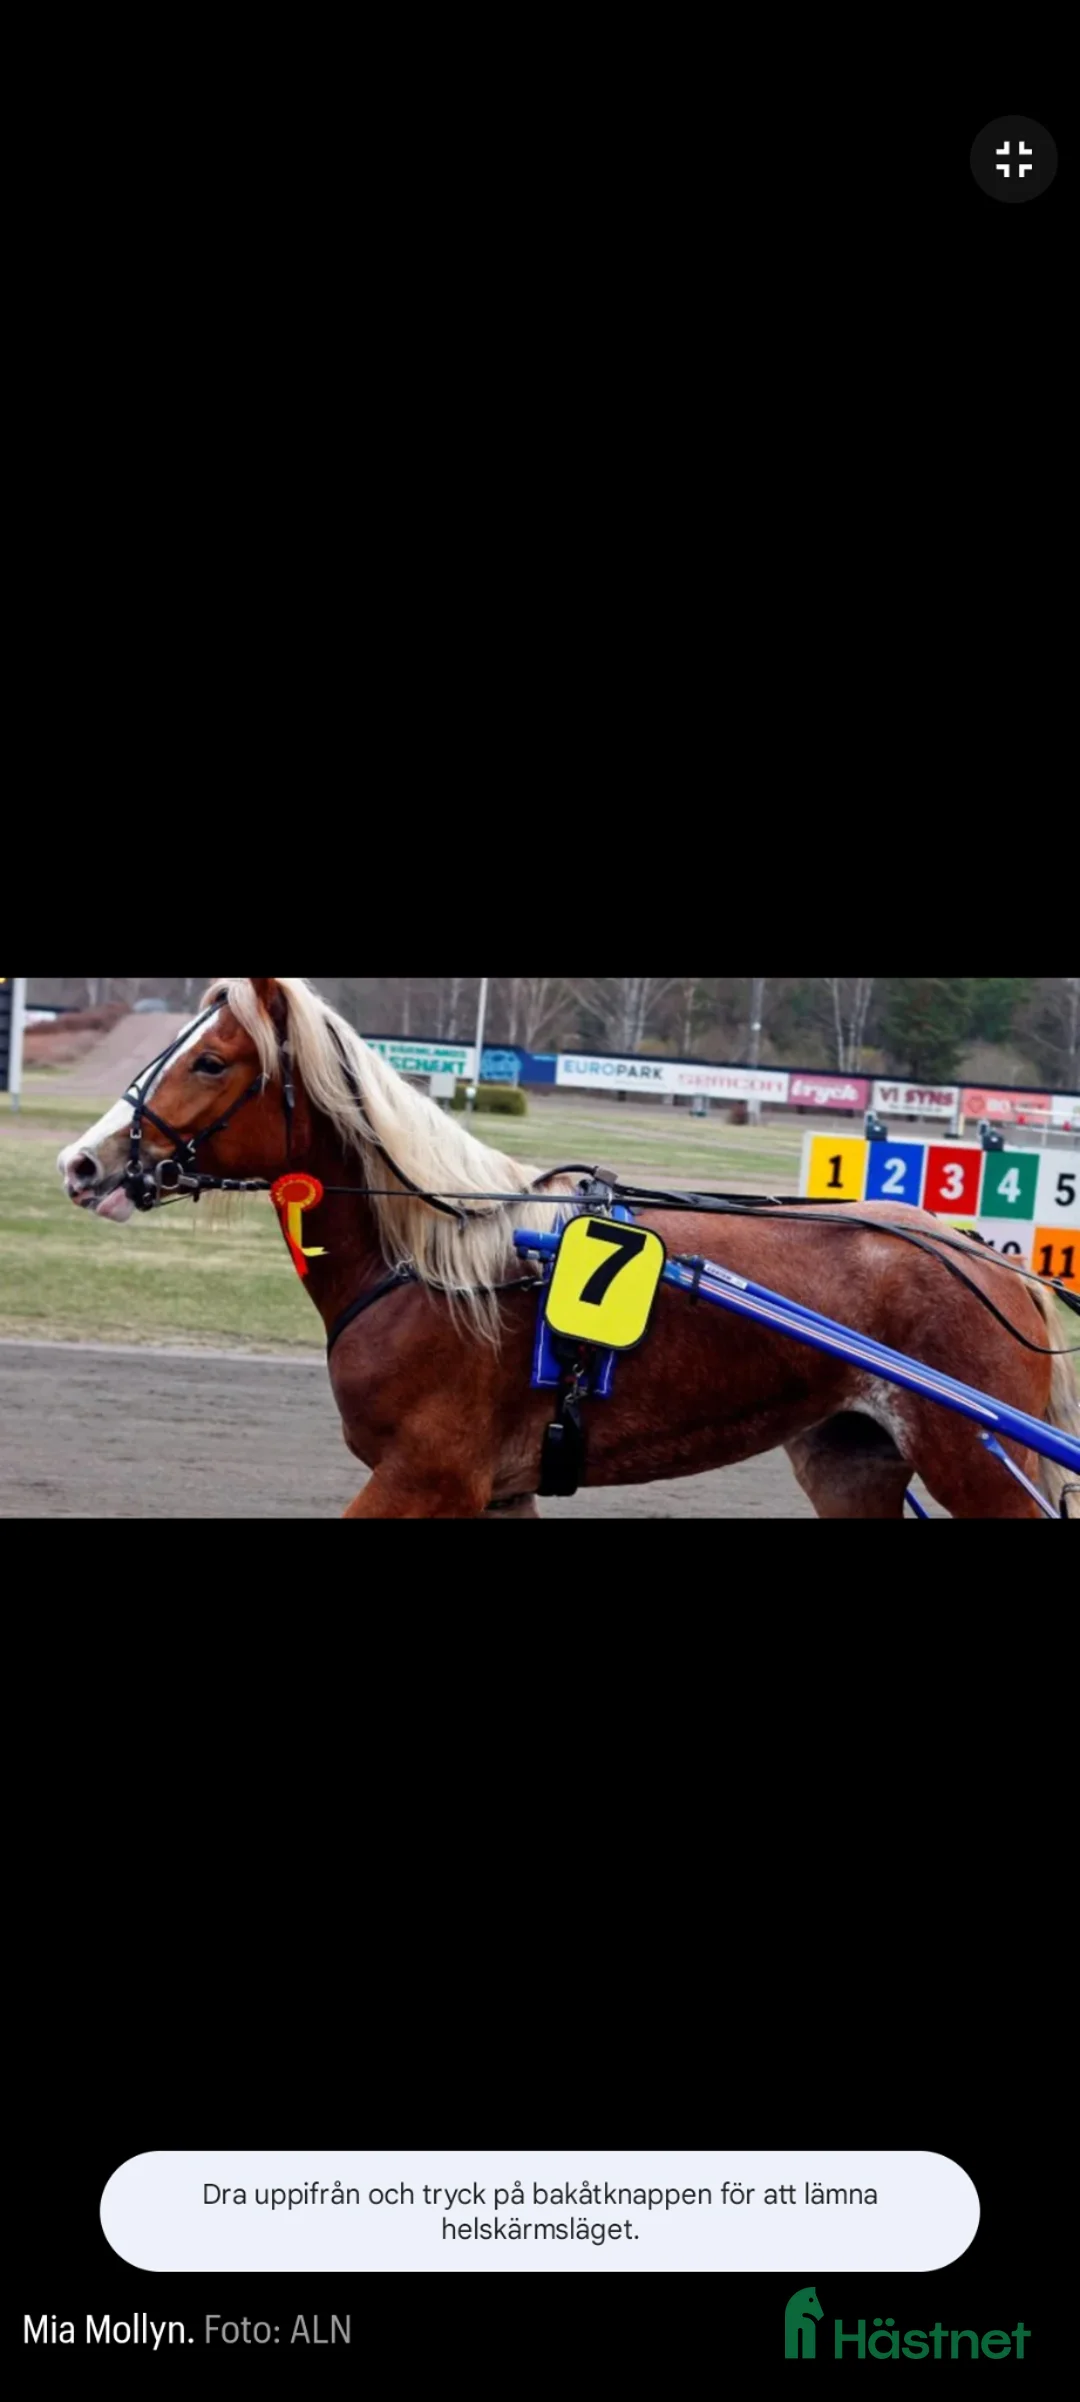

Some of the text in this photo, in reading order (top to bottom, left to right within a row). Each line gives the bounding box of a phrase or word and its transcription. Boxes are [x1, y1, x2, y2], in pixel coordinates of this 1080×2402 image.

[564, 1059, 663, 1080] EUROPARK
[827, 1155, 843, 1188] 1
[881, 1158, 907, 1194] 2
[939, 1163, 964, 1200] 3
[997, 1168, 1021, 1203] 4
[1054, 1173, 1077, 1206] 5
[578, 1219, 648, 1306] 7
[1037, 1244, 1075, 1278] 11
